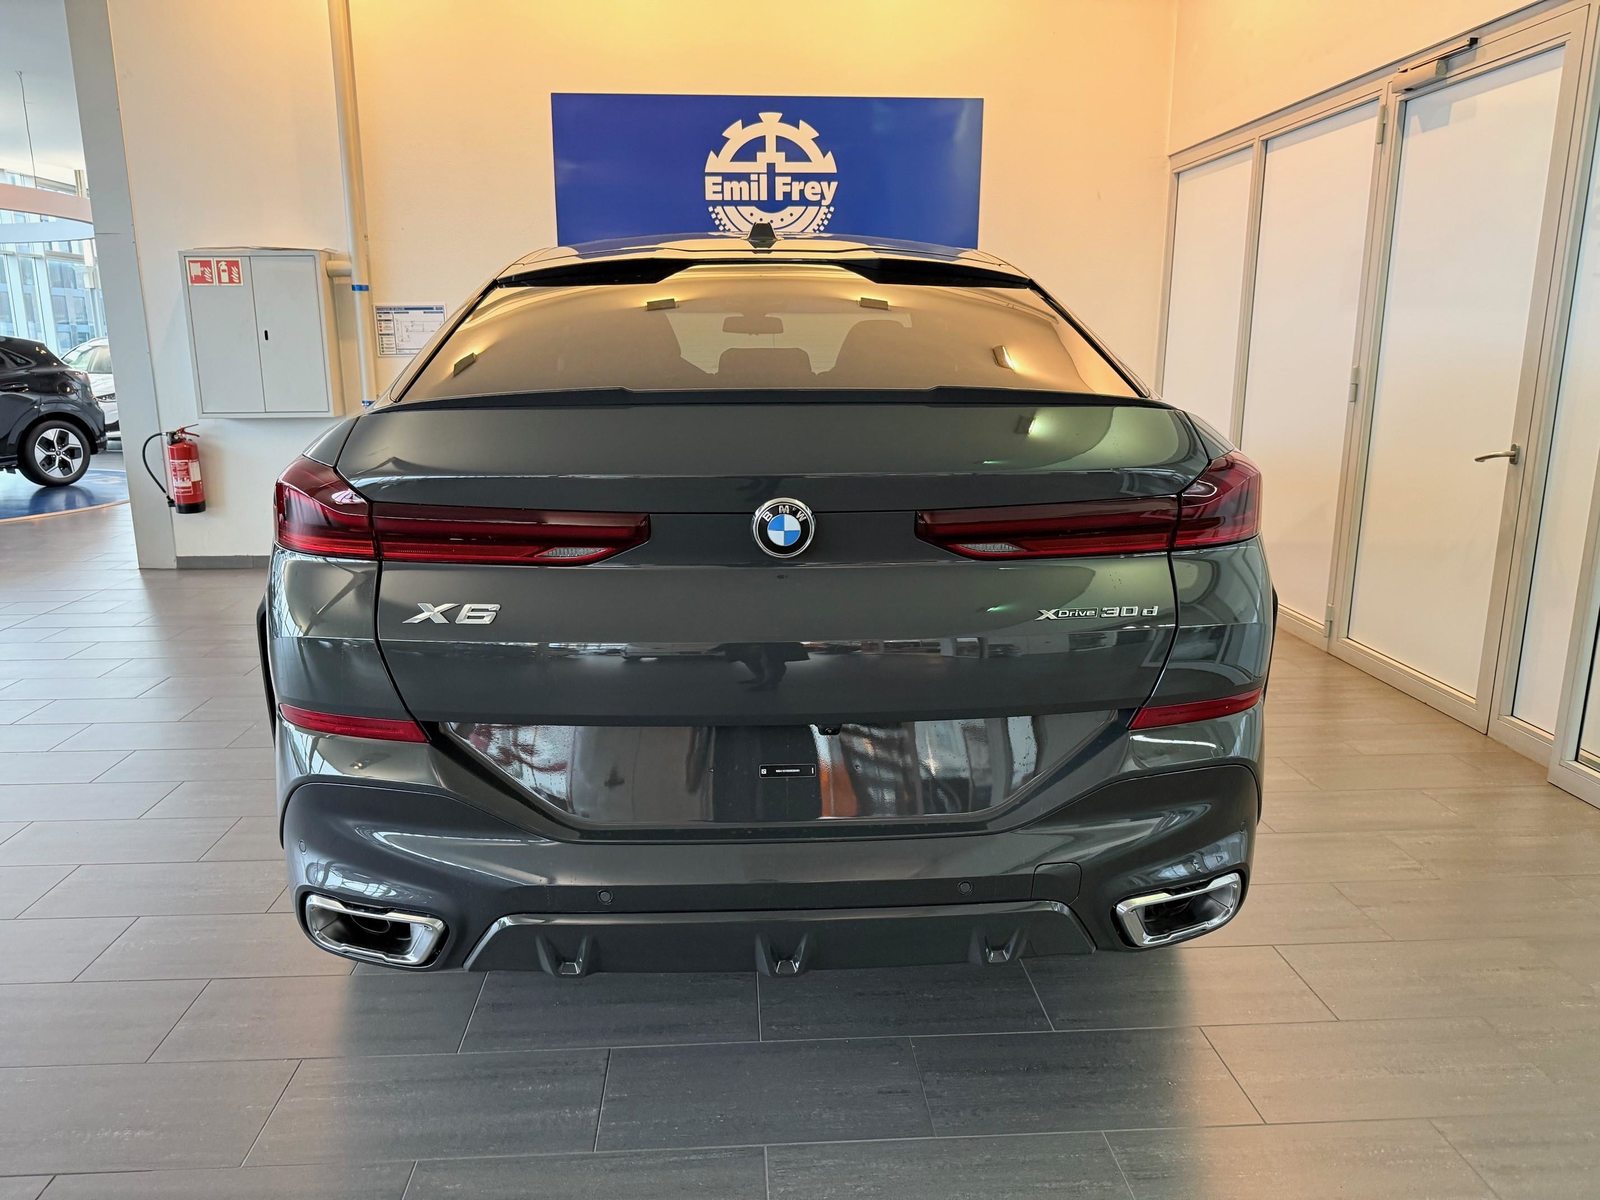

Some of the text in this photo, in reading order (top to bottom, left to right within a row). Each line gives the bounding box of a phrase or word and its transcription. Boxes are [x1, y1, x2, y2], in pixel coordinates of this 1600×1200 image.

[705, 174, 838, 205] Emil Frey
[761, 505, 806, 521] BMW
[402, 603, 500, 624] X6
